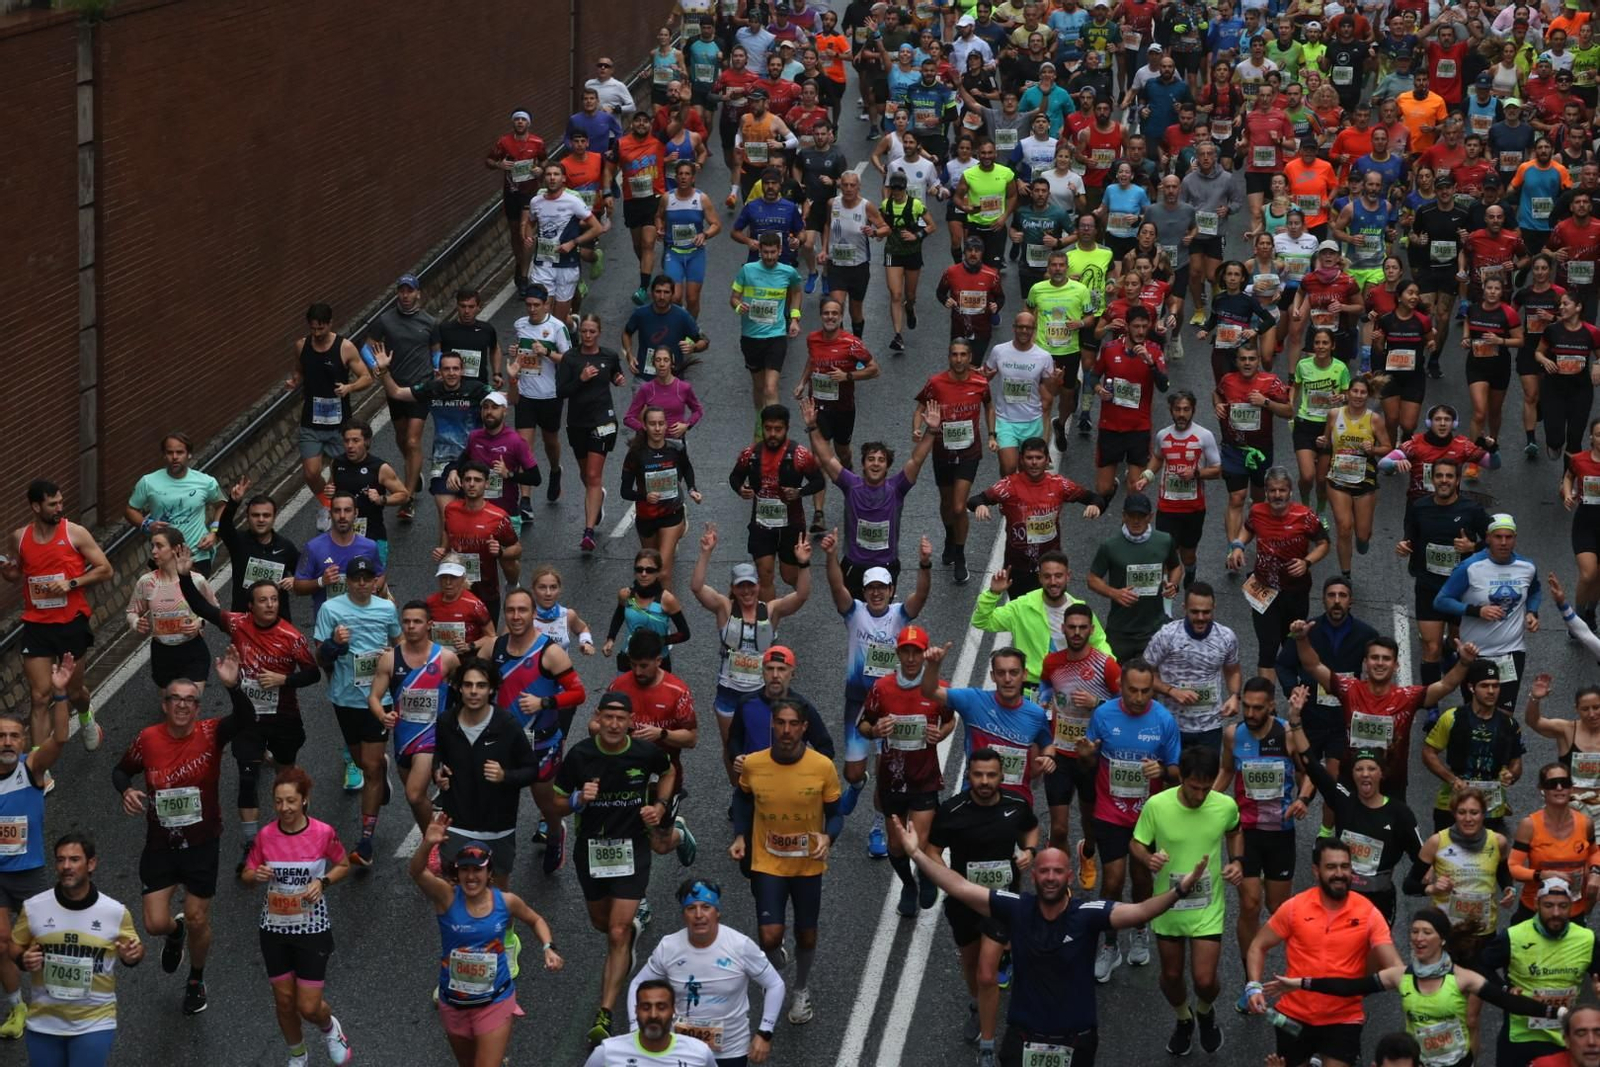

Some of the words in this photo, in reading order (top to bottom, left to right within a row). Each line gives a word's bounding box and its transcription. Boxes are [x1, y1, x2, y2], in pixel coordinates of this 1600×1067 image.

[1047, 326, 1068, 336] 15170
[1429, 551, 1452, 563] 7893
[251, 566, 275, 579] 9882
[871, 650, 896, 664] 8807
[401, 696, 432, 708] 17623
[1058, 722, 1087, 736] 12535
[1115, 769, 1141, 782] 6766
[1248, 771, 1275, 783] 6669
[162, 797, 190, 810] 7507
[772, 834, 798, 847] 5804
[596, 847, 623, 861] 8895
[974, 871, 1003, 884] 7339
[64, 932, 79, 943] 59
[51, 965, 81, 981] 7043
[1030, 1054, 1060, 1067] 8789
